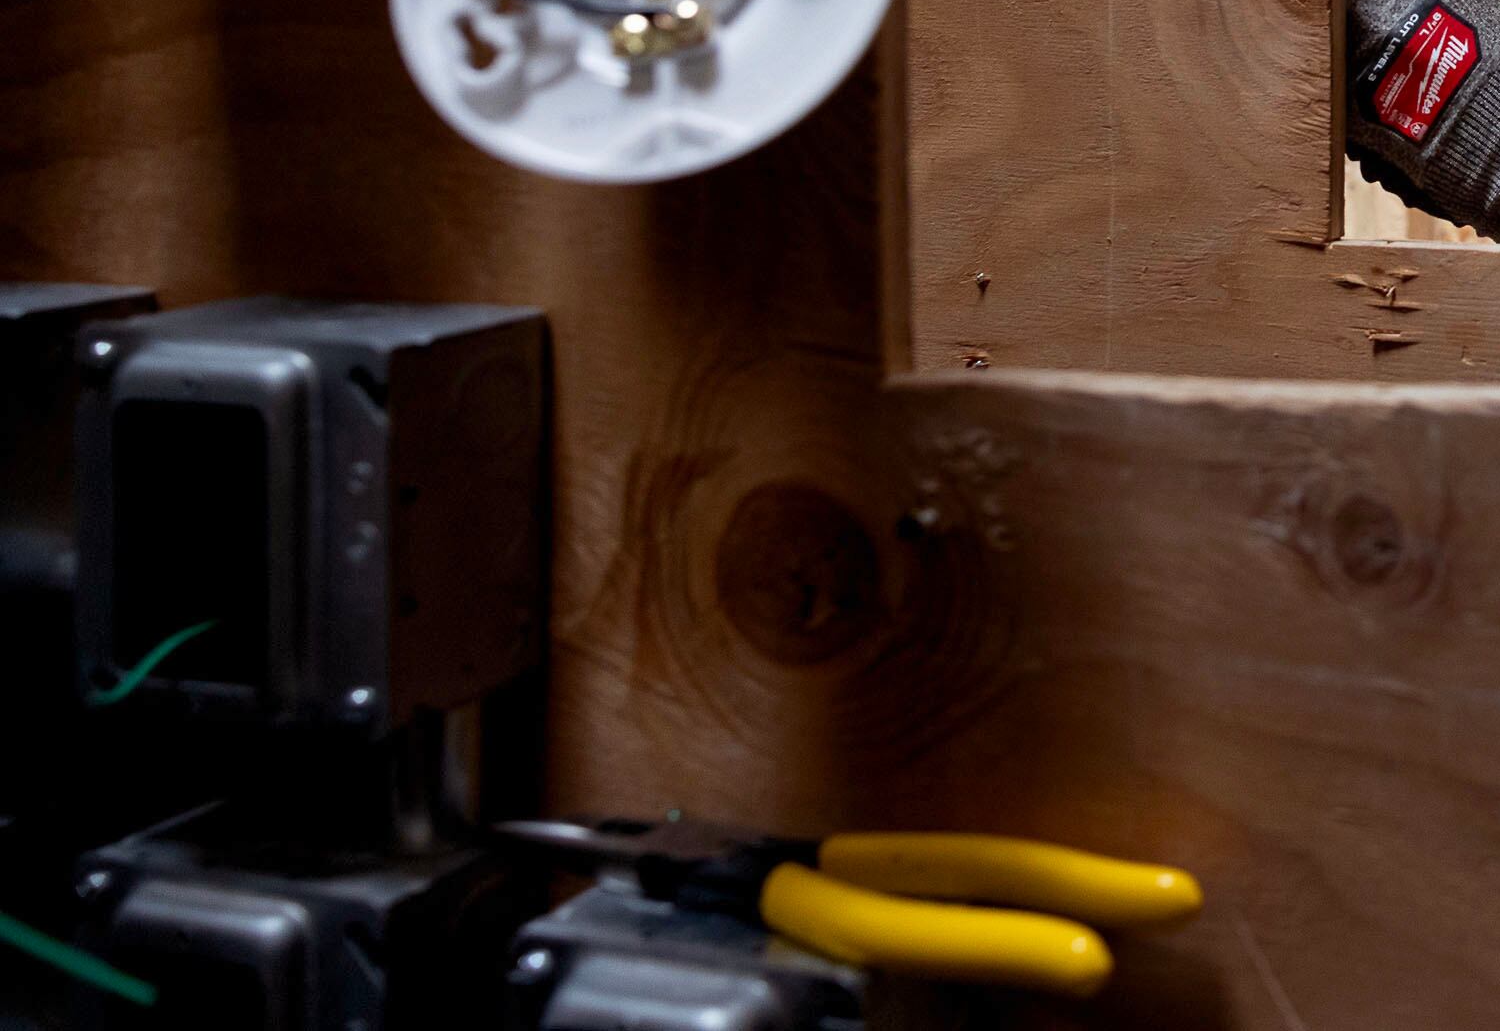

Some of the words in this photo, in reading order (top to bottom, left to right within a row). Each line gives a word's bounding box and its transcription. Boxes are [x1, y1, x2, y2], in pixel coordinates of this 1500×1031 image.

[1399, 13, 1420, 38] CUT
[1373, 37, 1401, 71] LEVEL
[1421, 35, 1469, 115] Milwaukee
